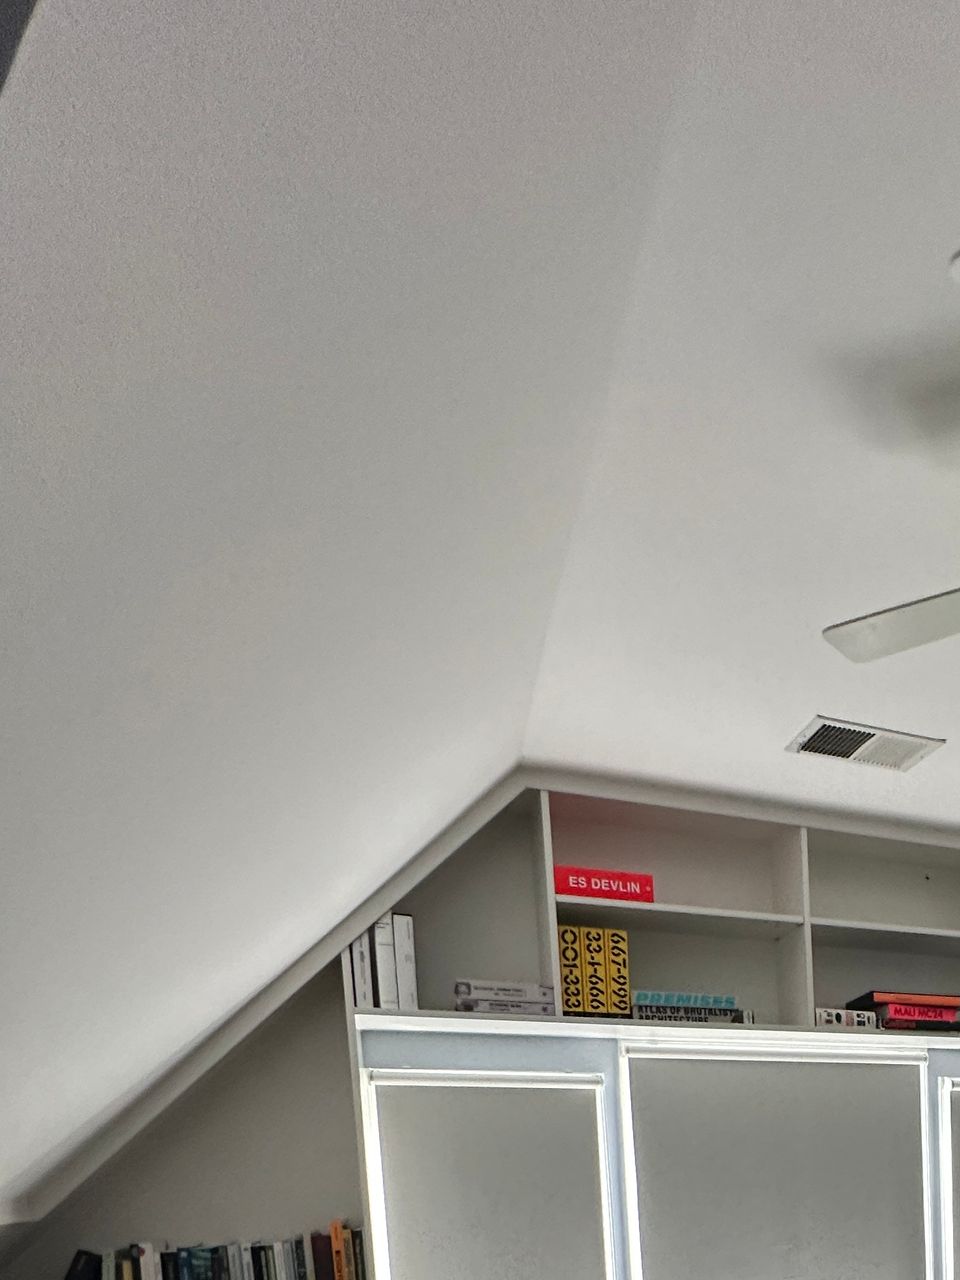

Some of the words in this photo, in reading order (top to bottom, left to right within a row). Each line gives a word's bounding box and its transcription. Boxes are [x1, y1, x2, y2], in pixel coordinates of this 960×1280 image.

[569, 876, 587, 889] ES
[591, 878, 640, 894] DEVLIN
[560, 928, 582, 1009] 001-333
[610, 932, 629, 1012] 667-999
[635, 991, 736, 1008] PREMISES
[638, 1005, 667, 1014] ATLAS
[670, 1006, 681, 1015] OF
[893, 1006, 916, 1017] MAU
